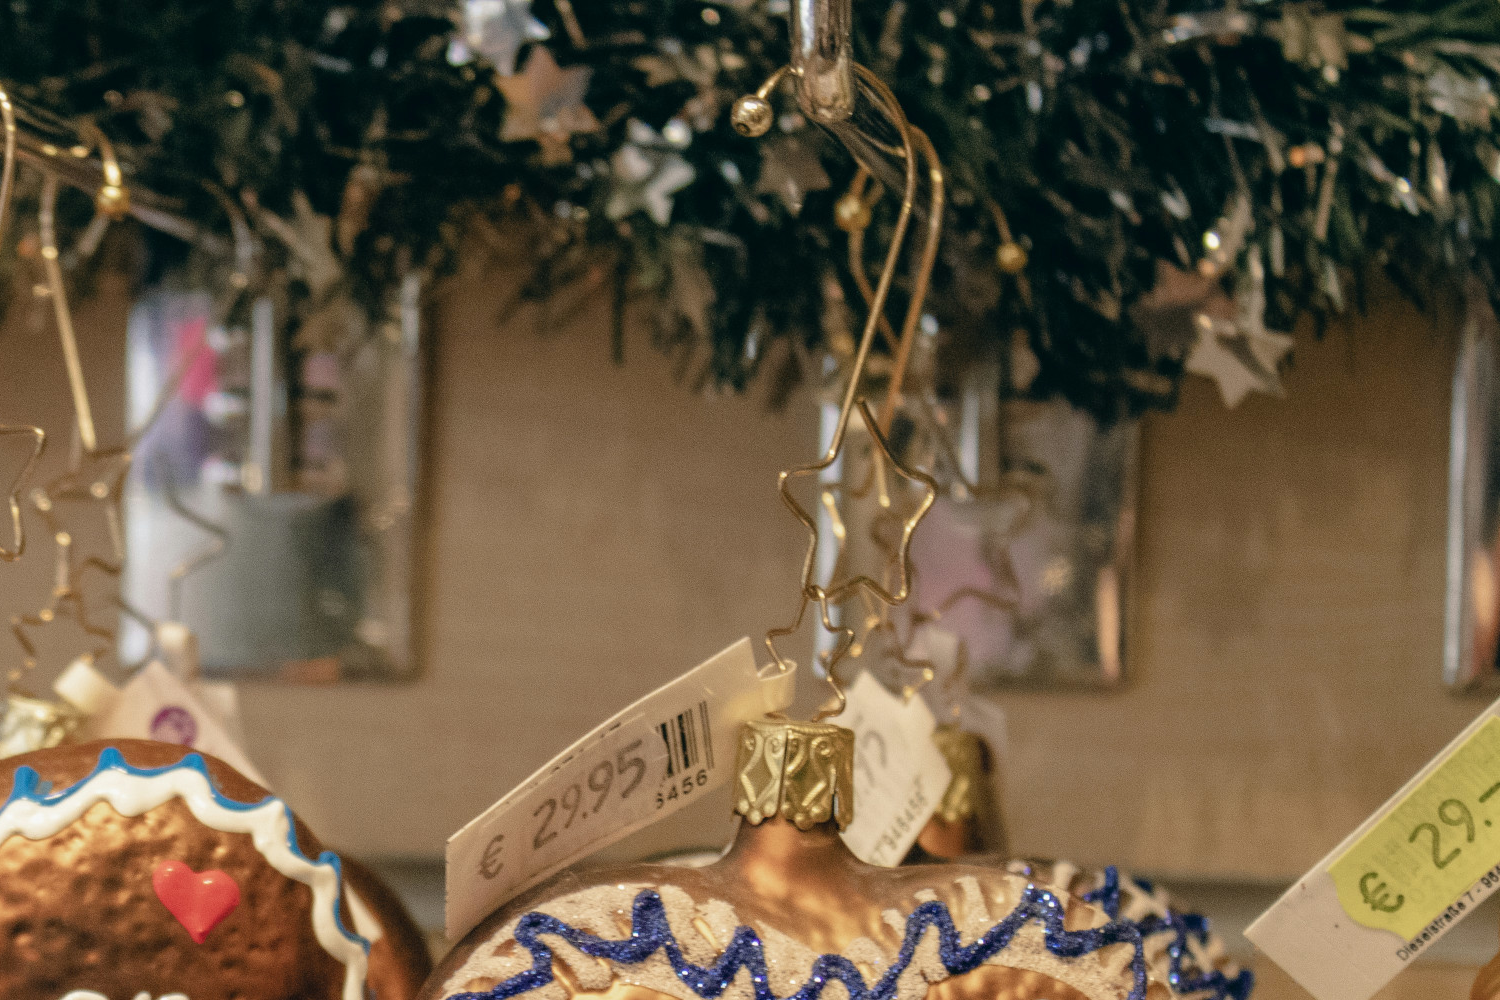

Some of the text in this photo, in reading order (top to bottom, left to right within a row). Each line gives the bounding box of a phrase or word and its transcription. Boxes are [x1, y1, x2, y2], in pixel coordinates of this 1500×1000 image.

[478, 834, 505, 880] €
[532, 739, 648, 851] 29.95
[1359, 871, 1405, 914] €
[1396, 902, 1466, 961] Dieselstraße
